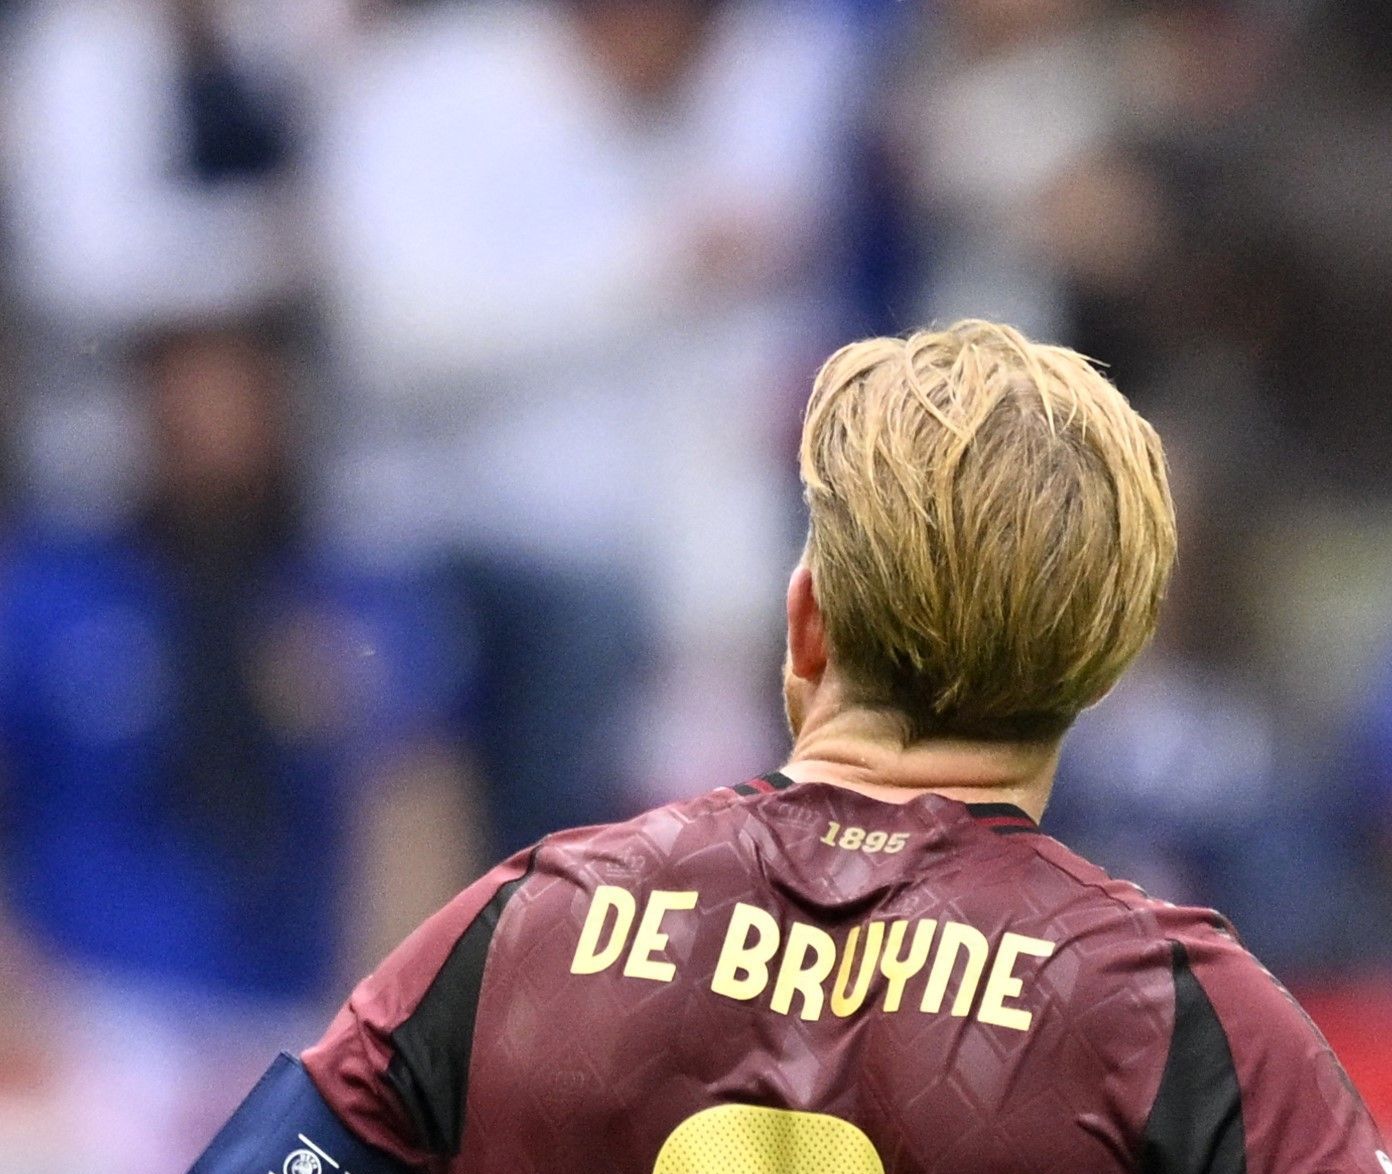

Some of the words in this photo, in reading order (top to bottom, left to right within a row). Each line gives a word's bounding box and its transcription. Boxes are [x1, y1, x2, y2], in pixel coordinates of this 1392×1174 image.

[818, 820, 909, 854] 1895
[571, 885, 698, 982] DE
[711, 902, 1055, 1032] BRUYNE
